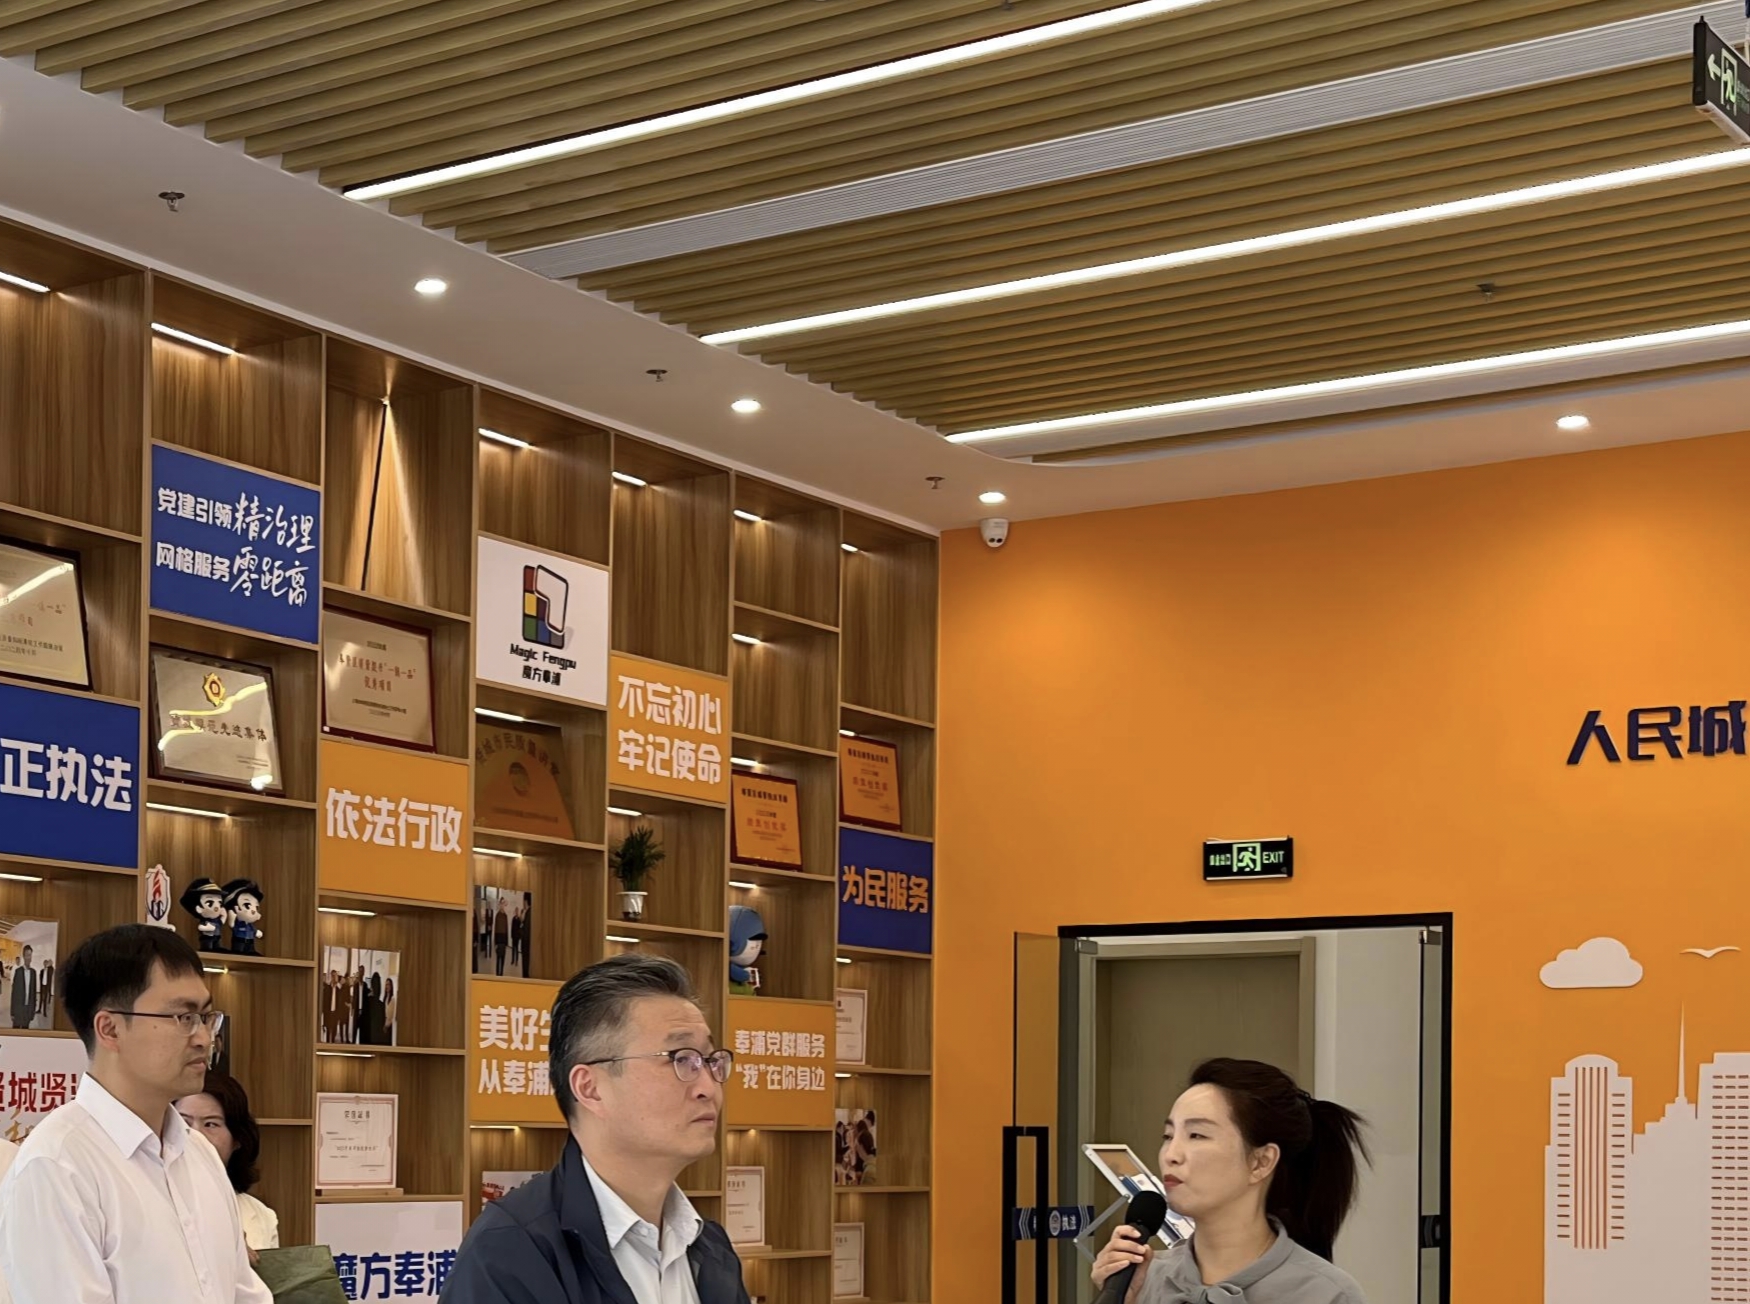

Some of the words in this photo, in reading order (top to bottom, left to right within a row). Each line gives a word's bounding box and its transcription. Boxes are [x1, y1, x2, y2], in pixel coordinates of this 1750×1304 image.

[509, 643, 538, 662] Magic
[543, 651, 576, 671] Fengpu
[618, 675, 722, 735] 不忘初心
[618, 729, 721, 785] 牢记使命
[325, 787, 463, 854] 依法行政
[1262, 851, 1285, 863] EXIT
[842, 865, 929, 913] 为民服务
[735, 1030, 825, 1058] 奉浦党群服务
[478, 1059, 555, 1096] 从奉浦
[735, 1063, 825, 1091] “我”在你身边
